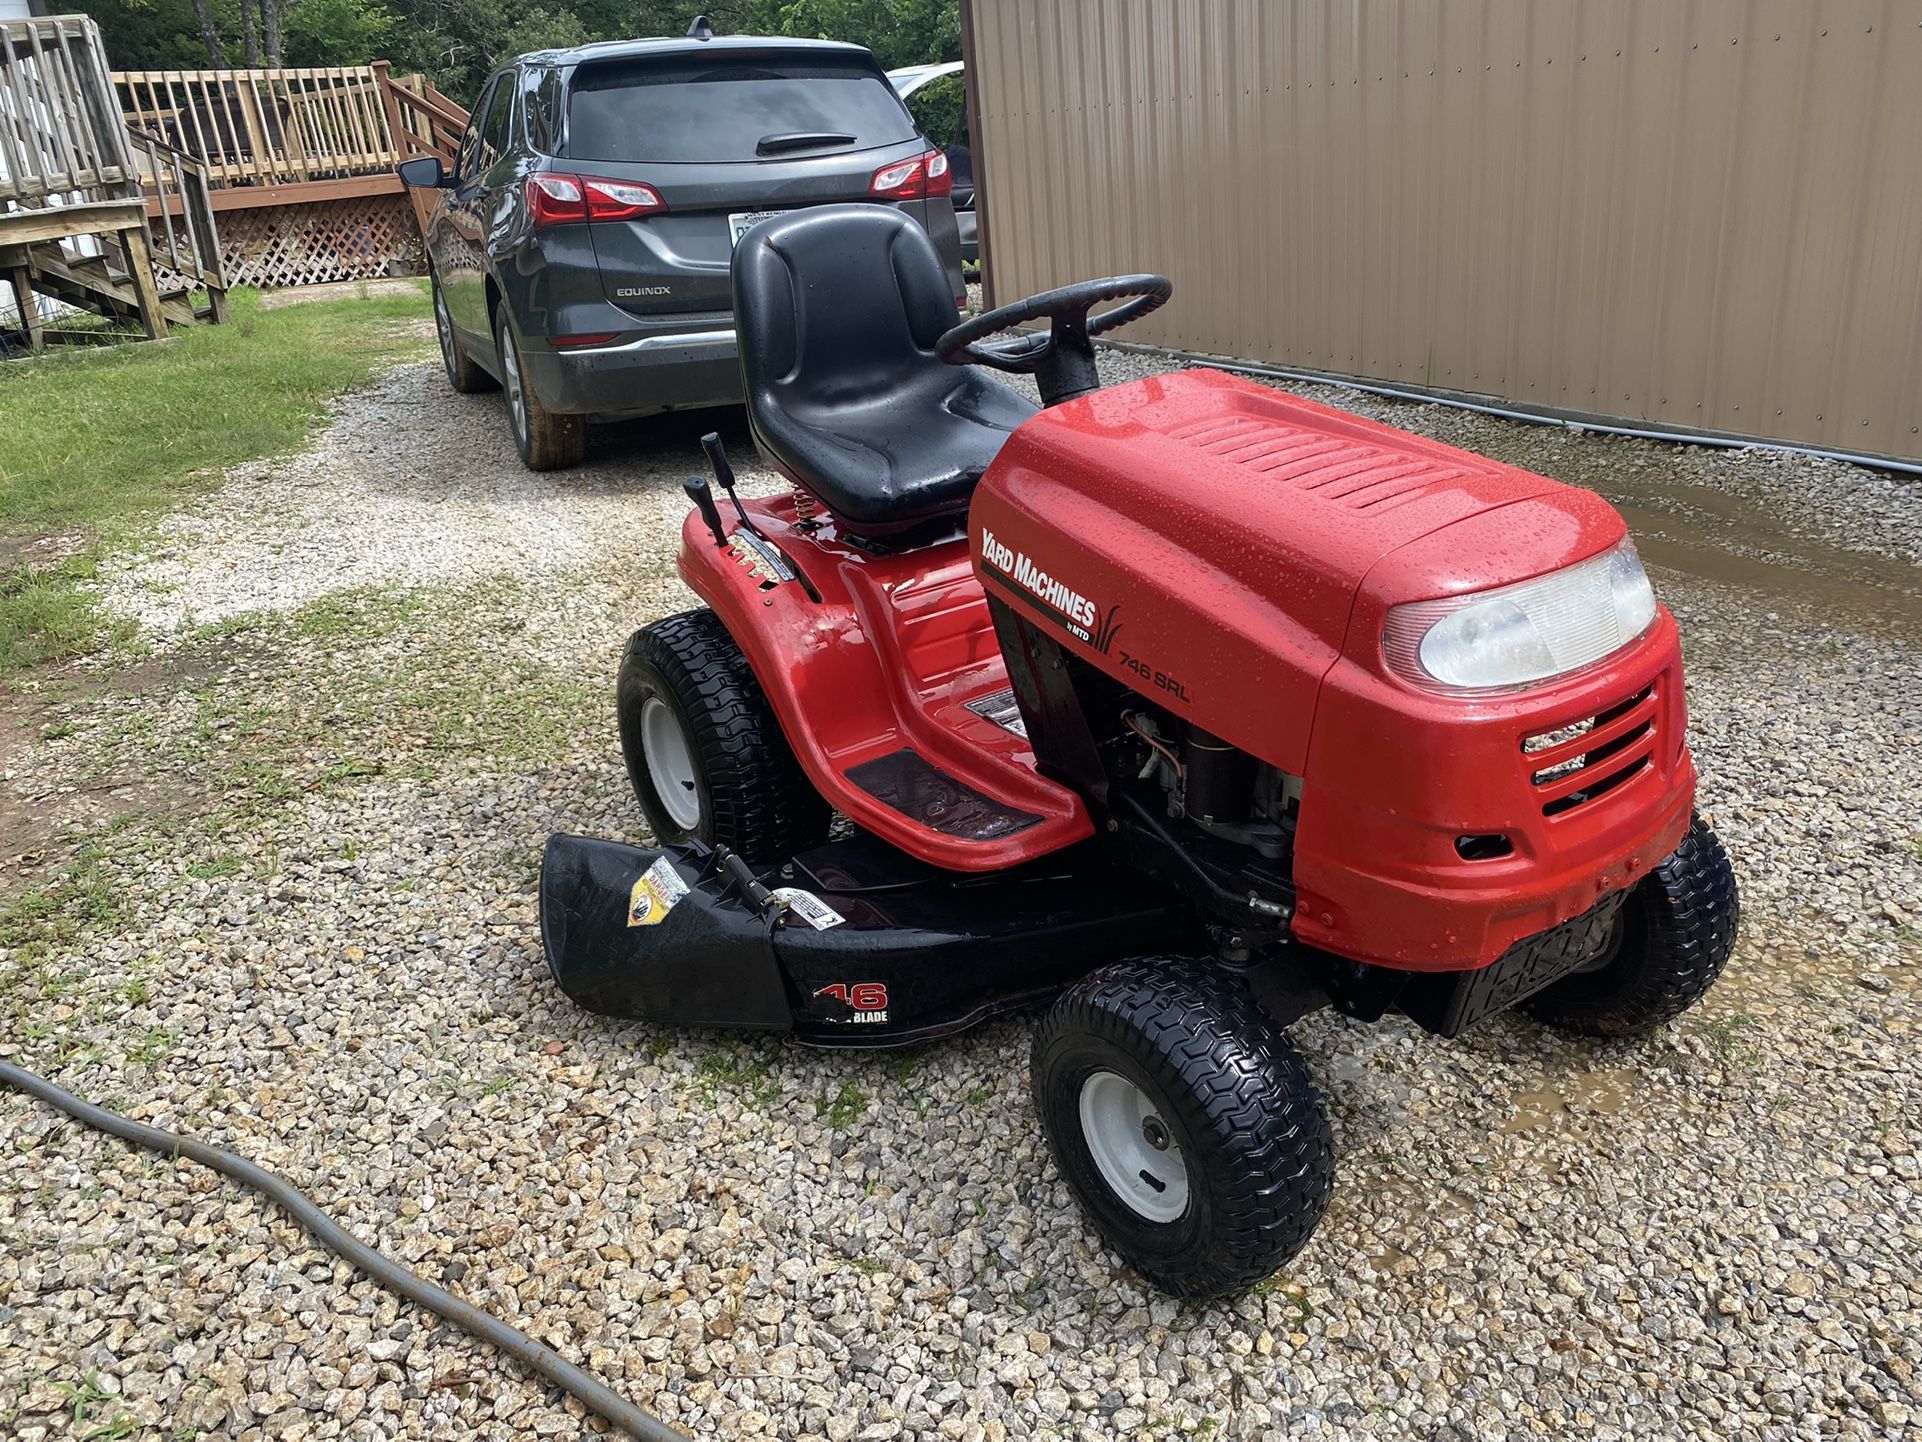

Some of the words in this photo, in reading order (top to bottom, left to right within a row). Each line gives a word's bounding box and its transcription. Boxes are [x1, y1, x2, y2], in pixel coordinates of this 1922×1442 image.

[616, 286, 671, 297] EQUINOX
[981, 527, 1013, 574] YARD
[1013, 552, 1096, 628] MACHINES
[1066, 621, 1073, 632] by
[1072, 624, 1090, 641] MTD
[1119, 650, 1152, 680] 746
[1154, 671, 1191, 703] SRL
[648, 874, 671, 903] DANGER
[853, 1011, 888, 1024] BLADE
